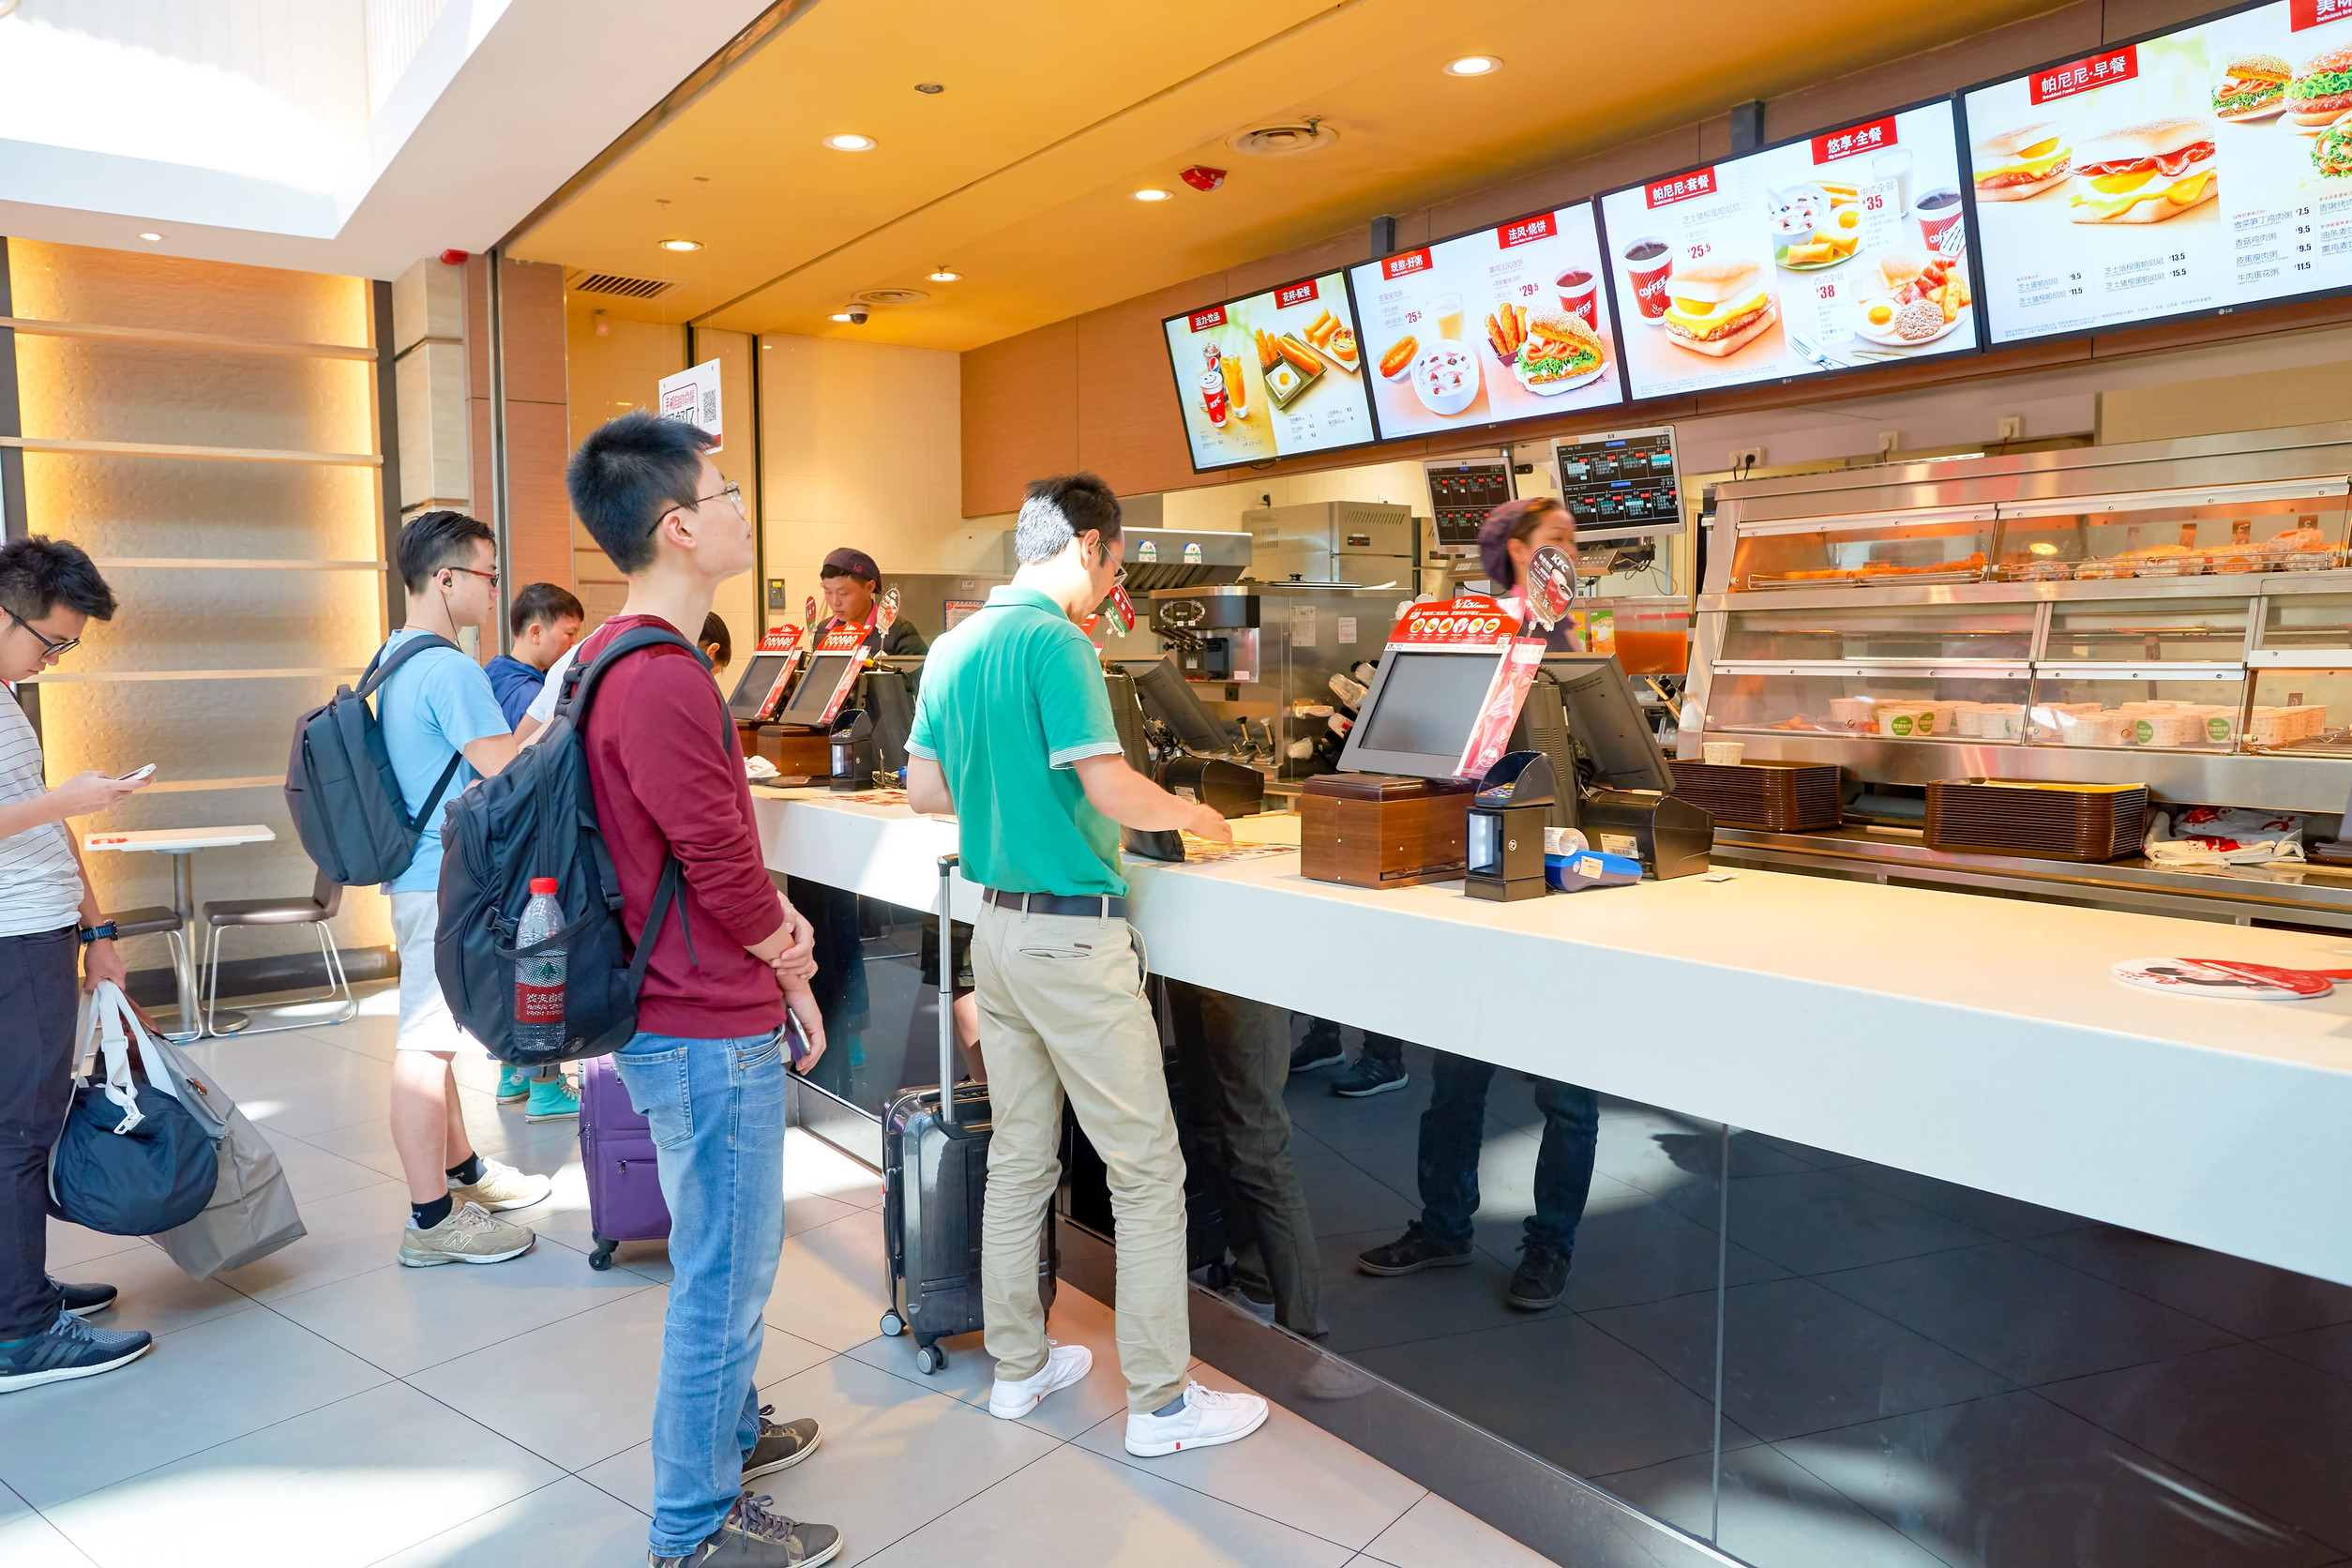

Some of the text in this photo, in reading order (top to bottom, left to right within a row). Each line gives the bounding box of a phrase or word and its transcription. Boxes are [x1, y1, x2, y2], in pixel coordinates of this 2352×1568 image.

[2316, 11, 2342, 23] Delicious
[2042, 55, 2126, 94] 帕尼尼·早餐
[1827, 127, 1881, 154] 悠享·全餐
[1652, 174, 1709, 201] 帕尼尼·套餐
[1862, 195, 1883, 210] ¥35
[2296, 206, 2310, 216] ¥7.5
[1508, 219, 1546, 241] 法风·烧饼
[2296, 225, 2311, 234] ¥9.5
[1687, 243, 1711, 259] ¥25.5
[2297, 244, 2312, 253] ¥9.5
[1390, 254, 1423, 272] 现熬·好粥
[2168, 252, 2185, 262] ¥13.5
[2169, 268, 2187, 277] ¥15.5
[2294, 262, 2311, 271] ¥11.5
[2069, 272, 2082, 280] ¥9.5
[1519, 282, 1539, 296] ¥29.5
[1816, 284, 1835, 299] ¥38
[2069, 287, 2083, 295] ¥11.5
[1405, 310, 1423, 324] ¥25.5
[1550, 553, 1570, 573] KFC
